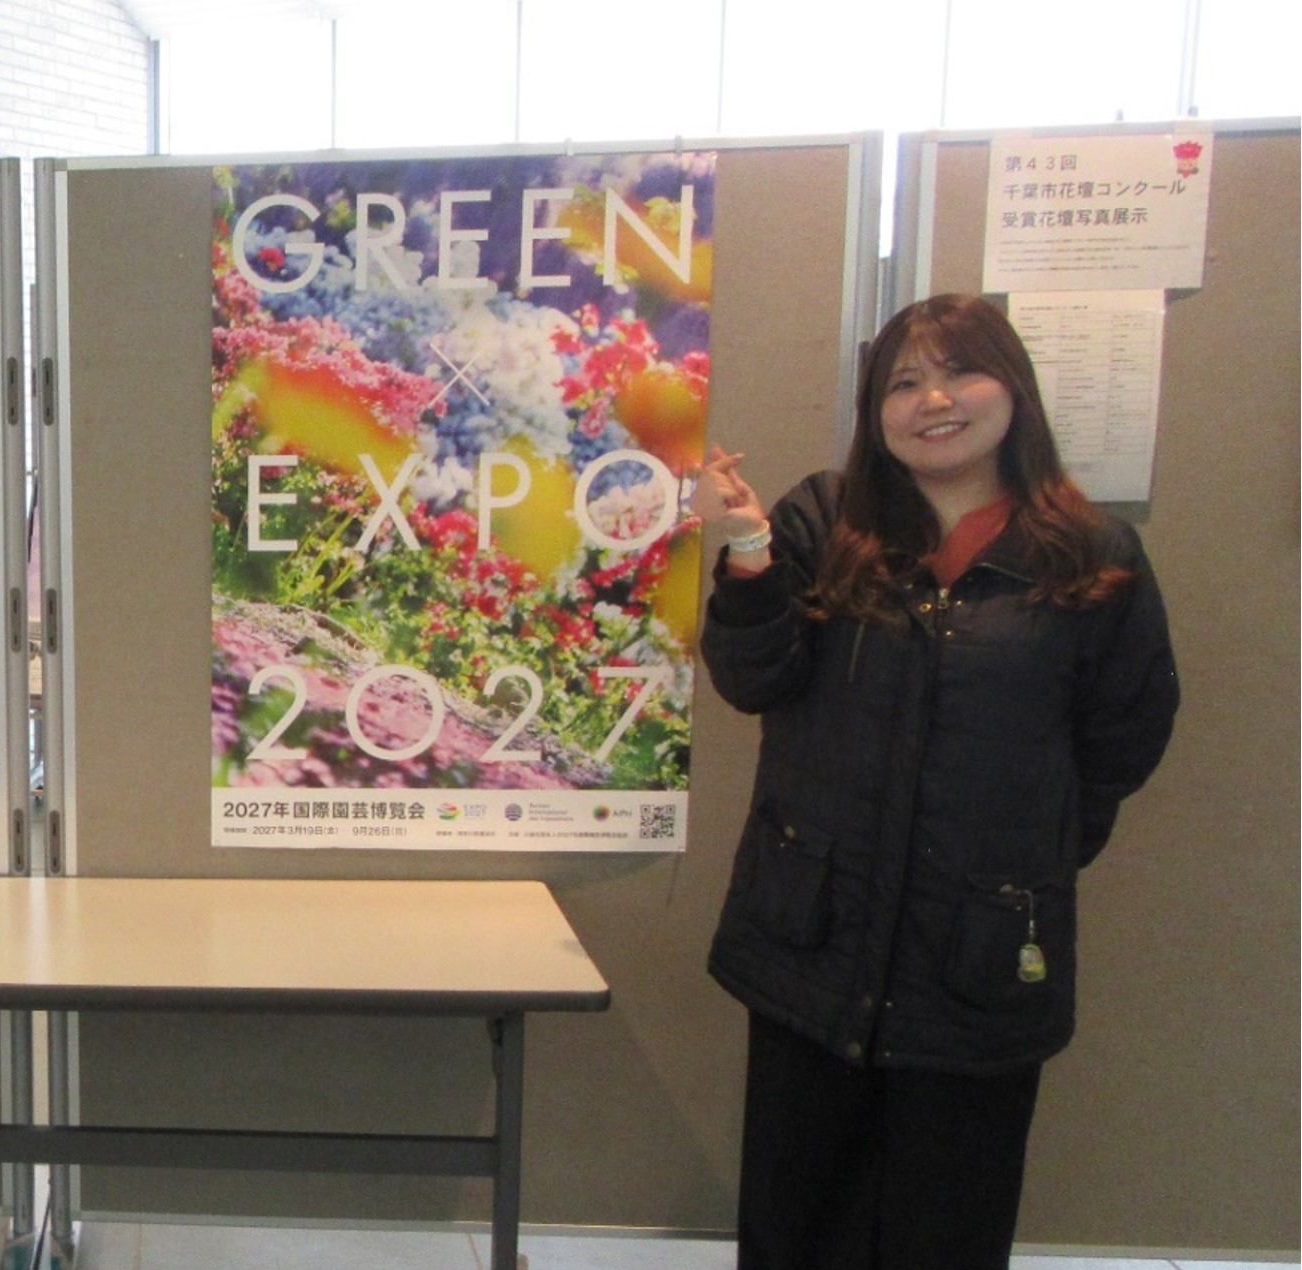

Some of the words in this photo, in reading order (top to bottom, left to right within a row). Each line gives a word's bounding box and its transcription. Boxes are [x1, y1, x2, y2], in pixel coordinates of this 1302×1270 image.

[1002, 207, 1148, 229] 受賞花壇写真展示
[1003, 180, 1186, 200] 千葉市花壇コンクール
[233, 184, 695, 293] GREEN
[247, 448, 679, 551] EXPO
[246, 663, 673, 762] 2027
[223, 801, 426, 820] 2027年国際園芸博覧会
